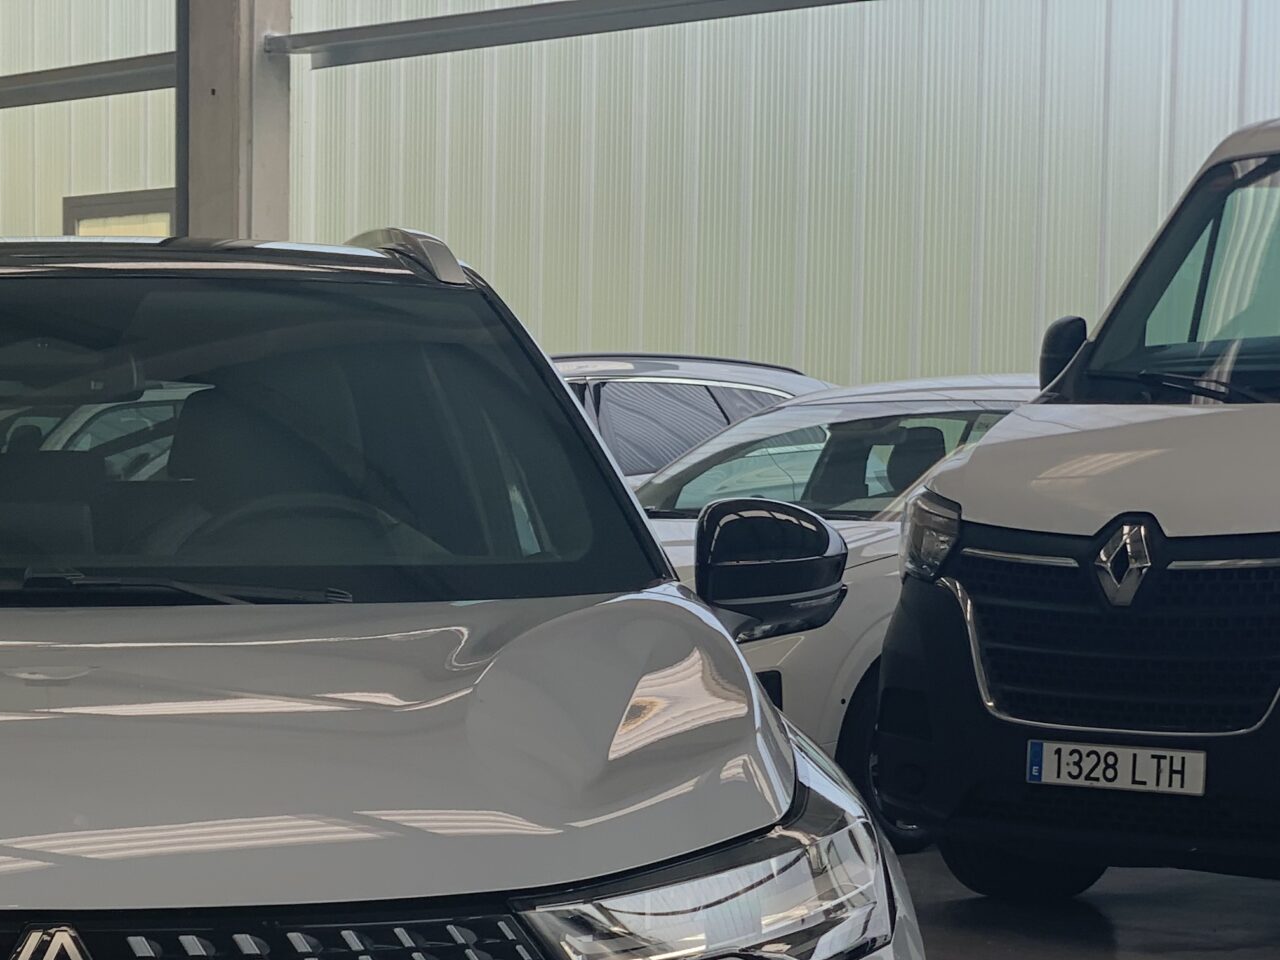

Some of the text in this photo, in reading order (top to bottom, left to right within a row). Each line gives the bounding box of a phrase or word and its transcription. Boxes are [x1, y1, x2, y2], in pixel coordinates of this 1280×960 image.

[1032, 747, 1186, 789] E 1328 LTH
